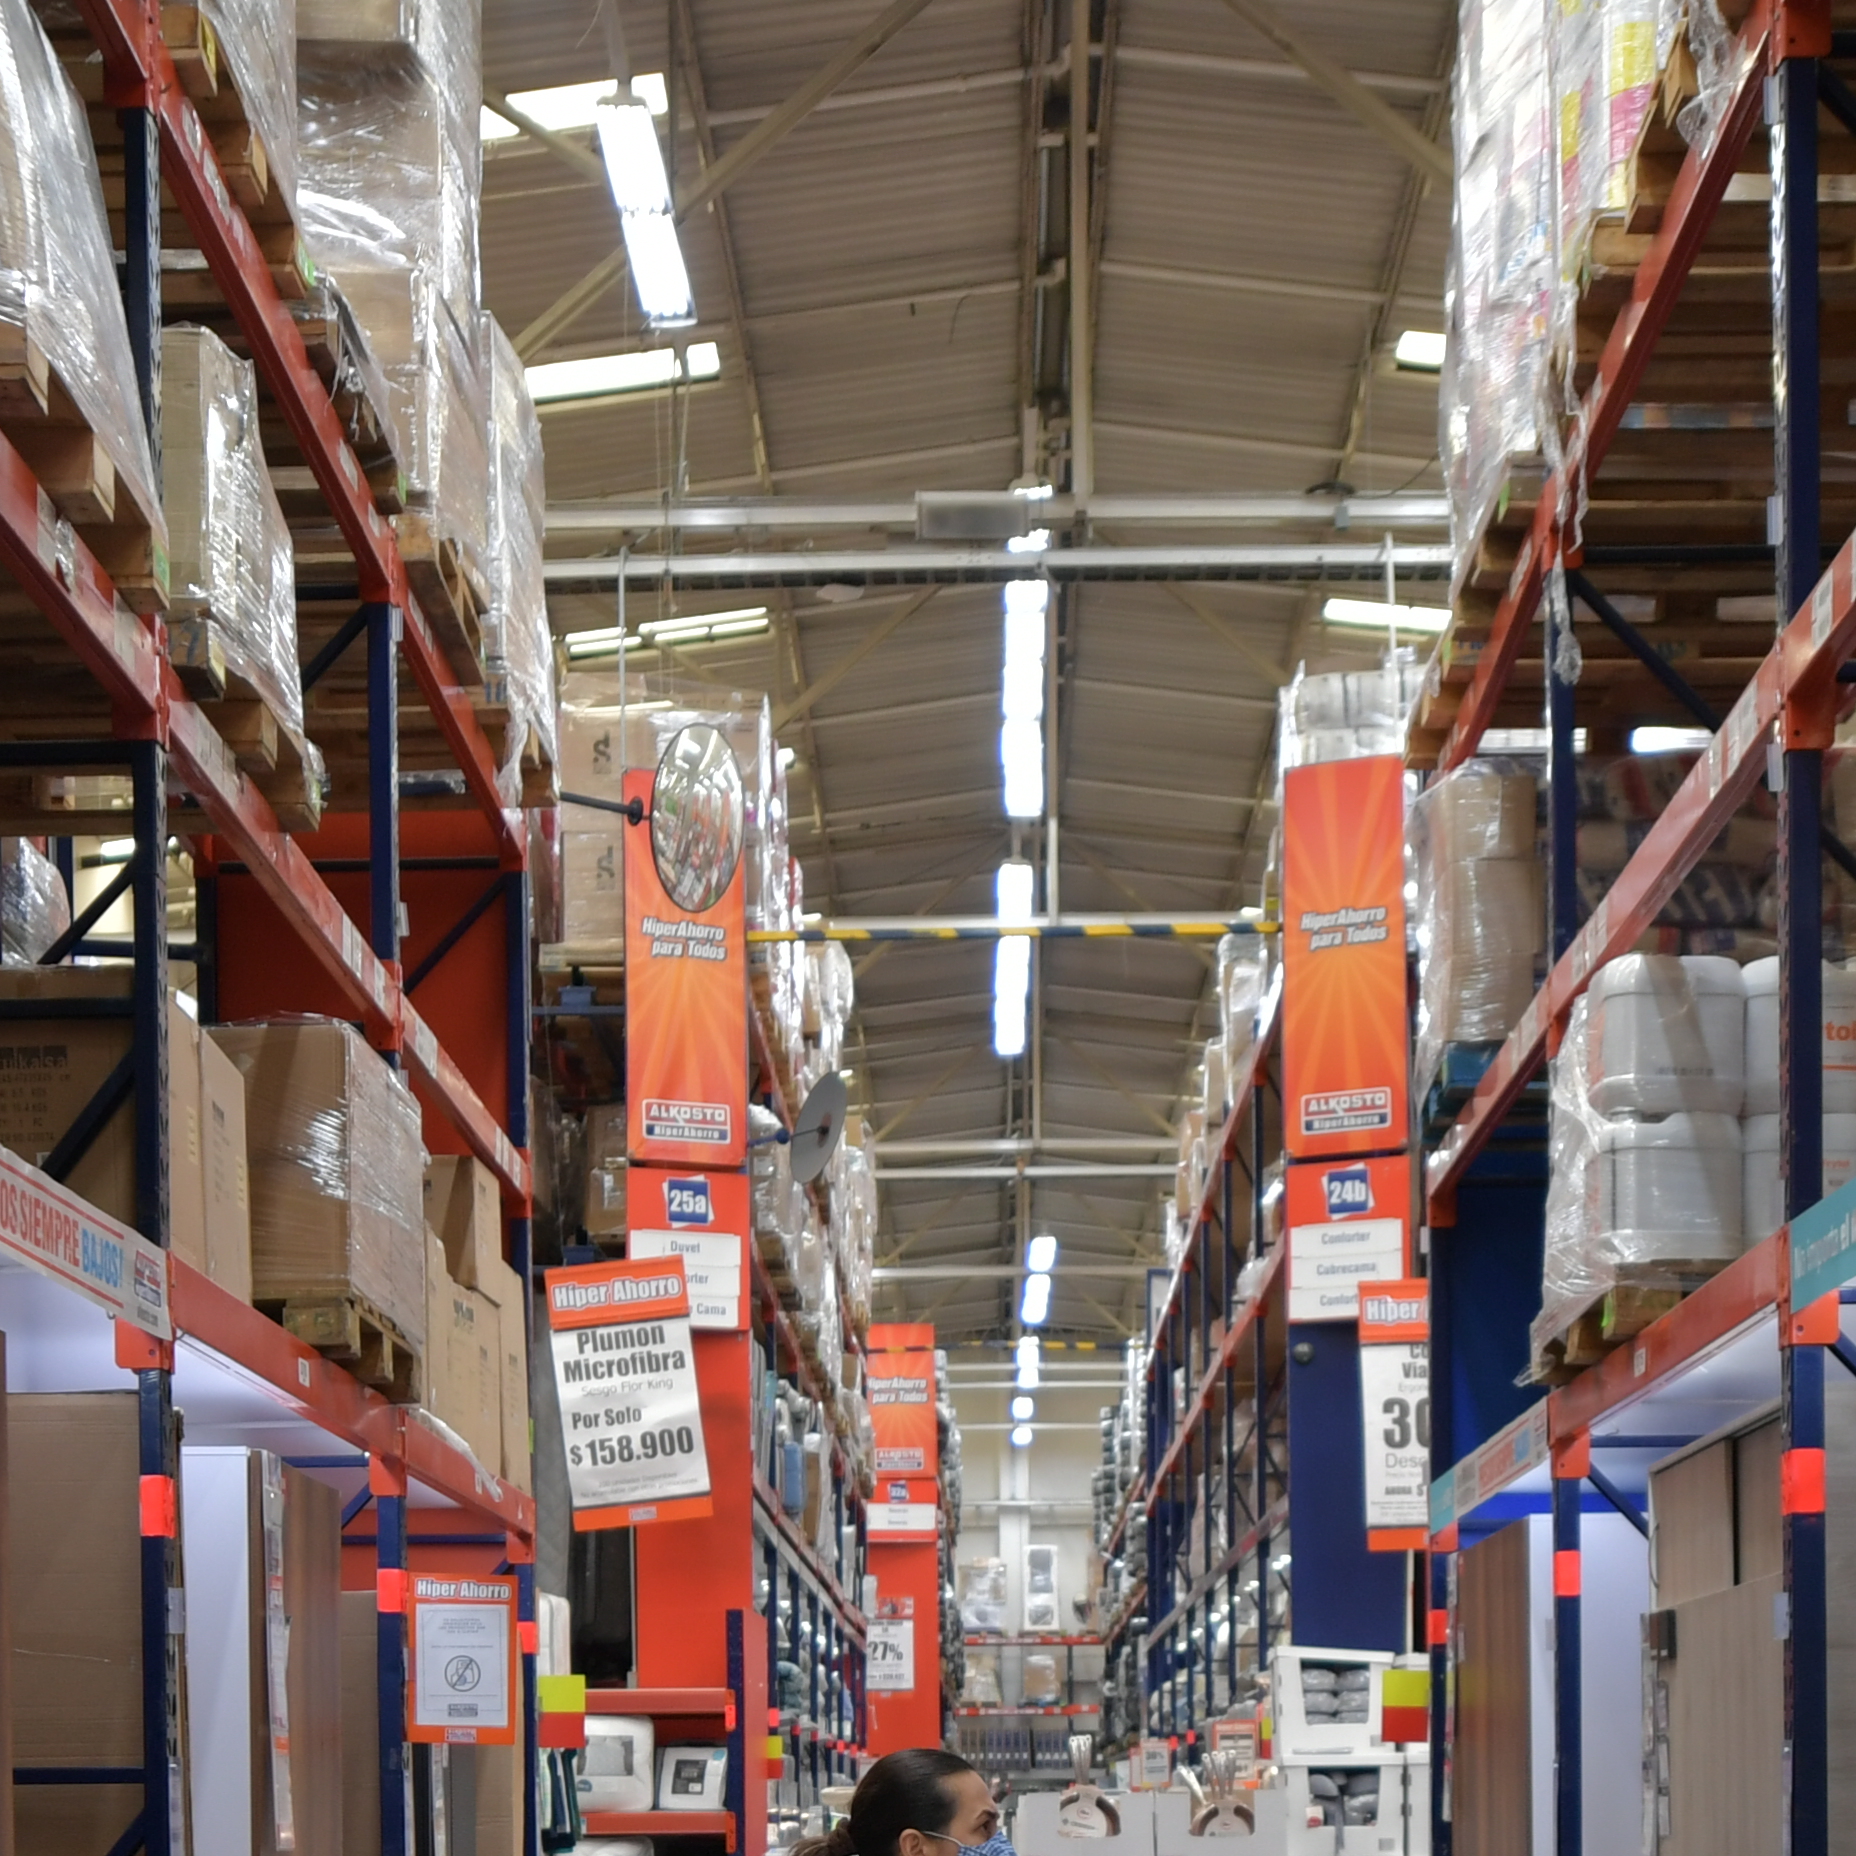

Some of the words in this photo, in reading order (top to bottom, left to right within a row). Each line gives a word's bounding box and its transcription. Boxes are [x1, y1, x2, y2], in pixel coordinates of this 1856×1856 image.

[642, 916, 725, 941] HiperAhorro
[1300, 907, 1386, 932] HiperAhorro
[651, 940, 684, 957] para
[687, 940, 726, 960] Todos
[1310, 929, 1343, 950] para
[1346, 925, 1387, 946] Todos
[650, 1103, 726, 1126] ALKOSTO
[1307, 1091, 1387, 1115] ALKOSTO
[654, 1124, 720, 1140] HiperAhorro
[669, 1188, 707, 1214] 25a
[1329, 1180, 1368, 1205] 24b
[19, 1190, 80, 1268] SIEMPRE
[81, 1227, 125, 1289] BAJOS!
[670, 1239, 701, 1254] Duvet
[553, 1282, 610, 1311] Hiper
[611, 1275, 683, 1301] Ahorro
[696, 1303, 726, 1316] Cama
[1365, 1298, 1420, 1323] Hiper
[576, 1324, 666, 1355] Plumon
[563, 1349, 687, 1384] Microfibra
[621, 1380, 644, 1394] Flor
[647, 1377, 674, 1393] King
[873, 1392, 896, 1404] para
[898, 1390, 928, 1403] Todos
[571, 1412, 600, 1431] Por
[603, 1405, 643, 1427] Solo
[416, 1578, 458, 1598] Hiper
[460, 1580, 511, 1600] Ahorro
[867, 1640, 904, 1662] 27%
